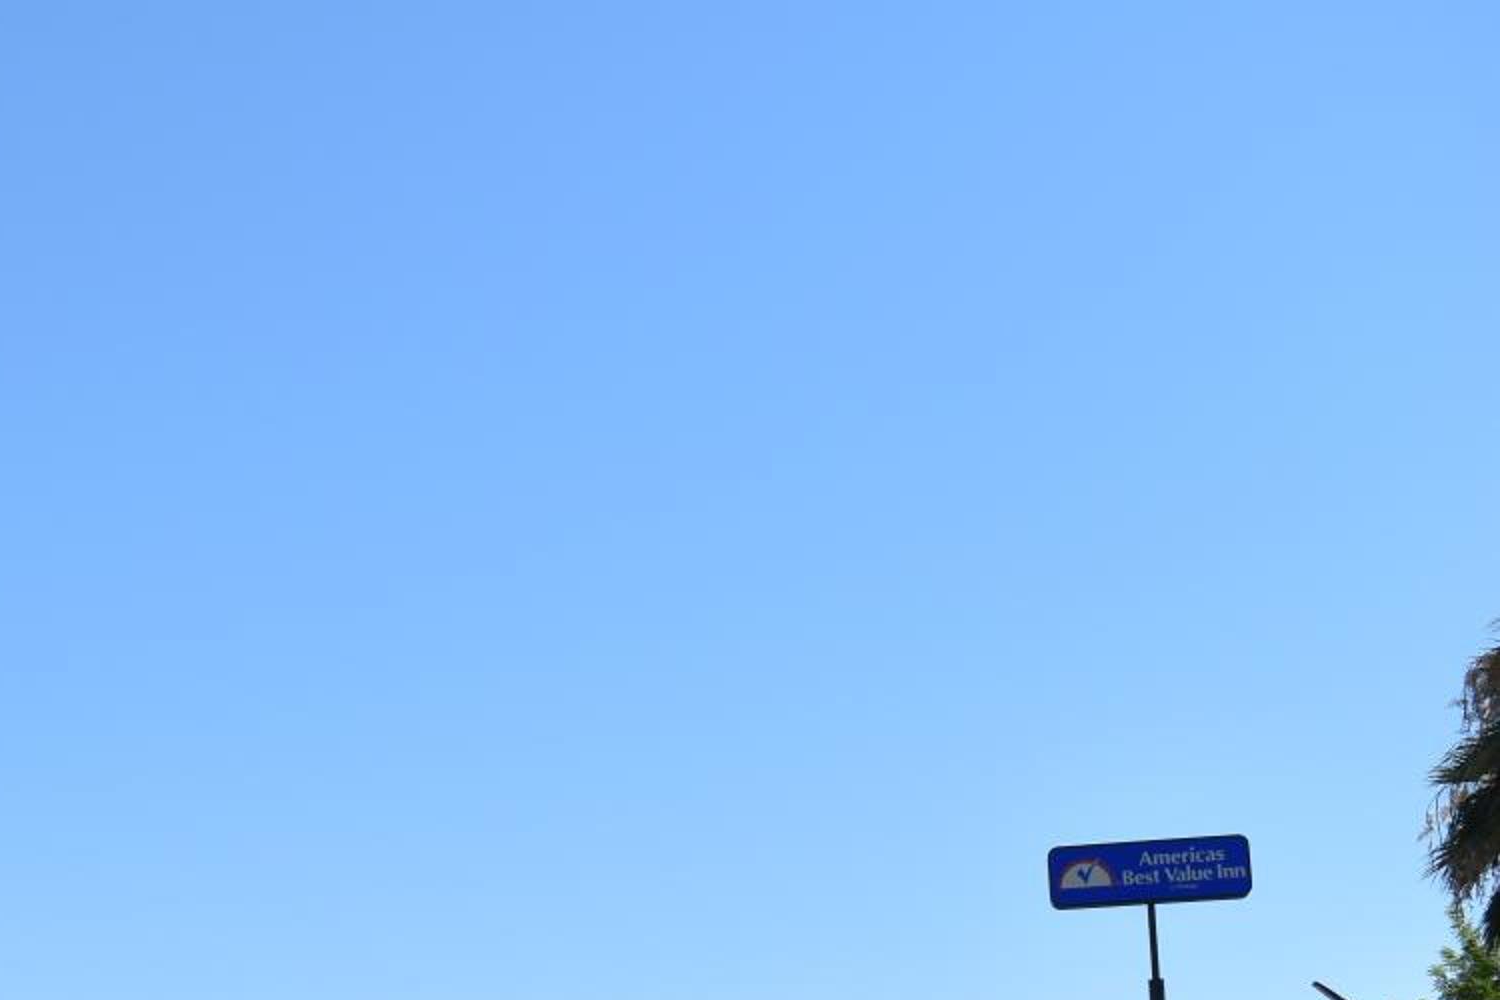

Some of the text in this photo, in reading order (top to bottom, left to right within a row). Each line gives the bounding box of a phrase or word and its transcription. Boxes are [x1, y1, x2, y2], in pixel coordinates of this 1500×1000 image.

[1139, 847, 1226, 866] Americas
[1122, 864, 1247, 886] Best Value Inn
